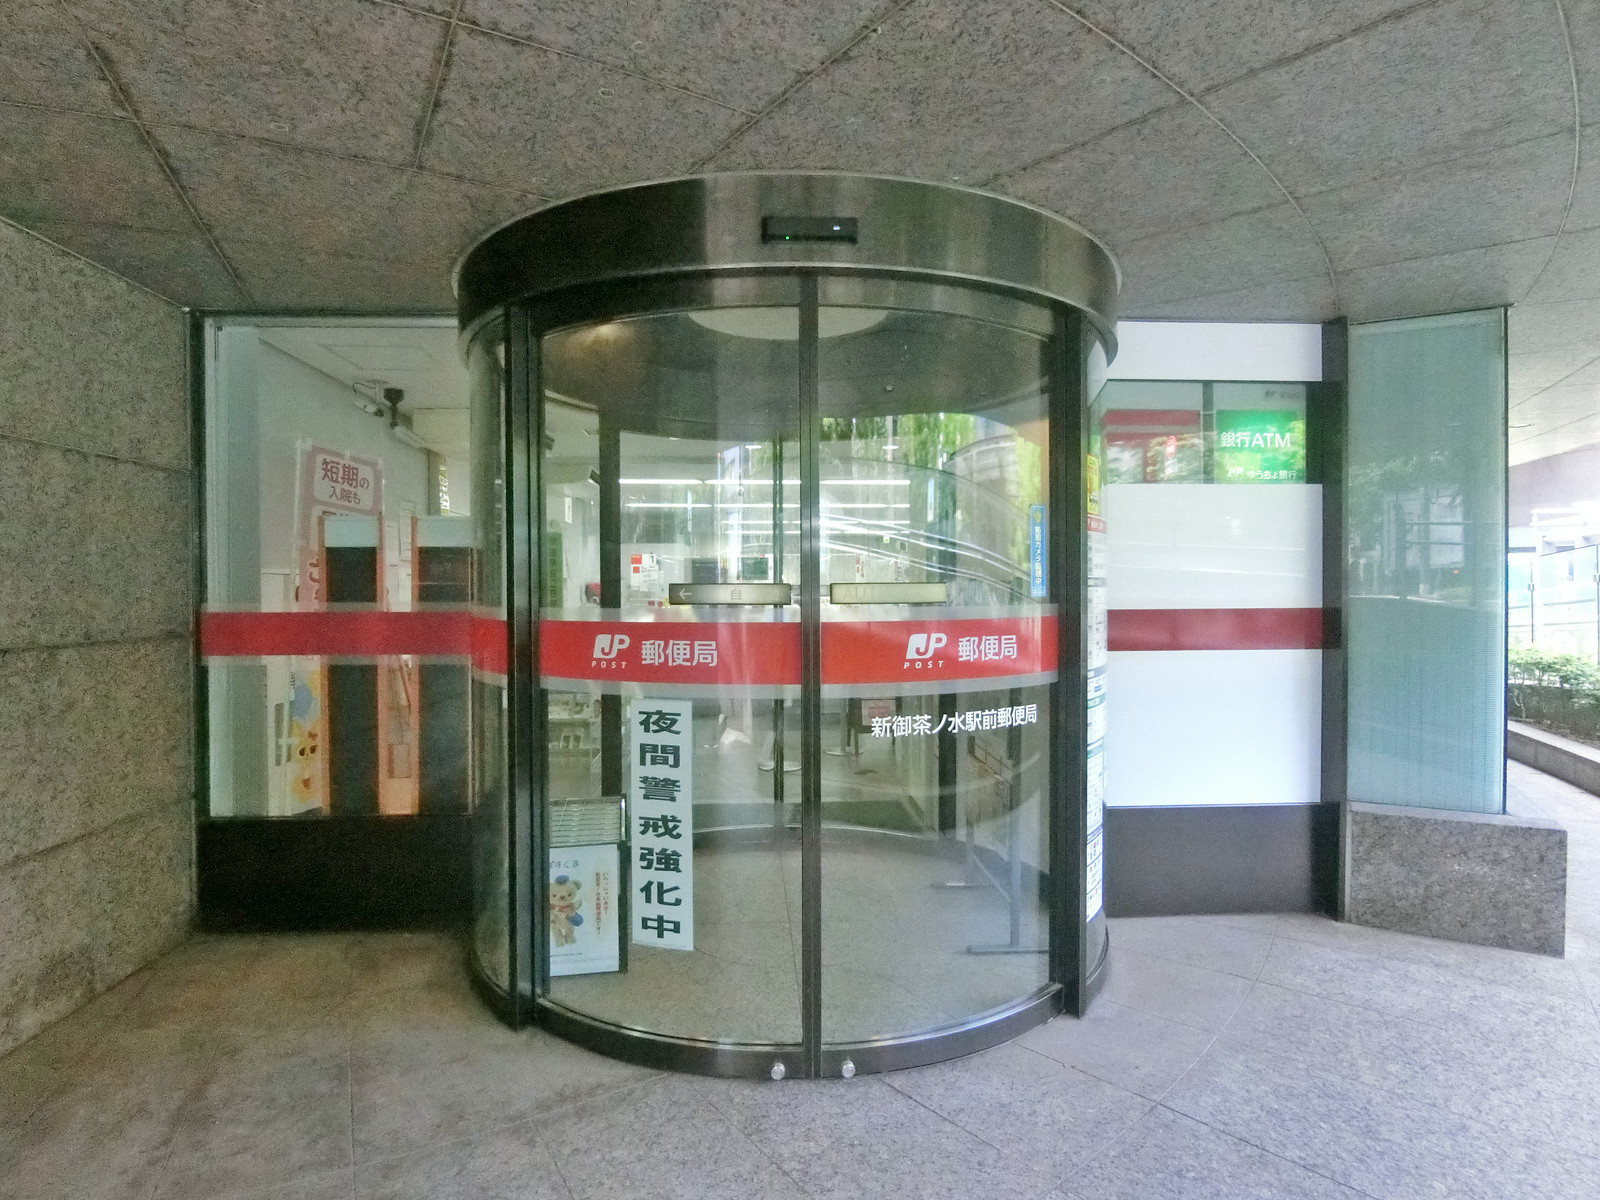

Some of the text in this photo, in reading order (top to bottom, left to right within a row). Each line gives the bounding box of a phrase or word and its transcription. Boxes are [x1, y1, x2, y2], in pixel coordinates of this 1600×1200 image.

[1221, 432, 1291, 448] 銀行ATM
[321, 458, 370, 490] 短期の
[1247, 469, 1297, 480] ゆうちょ銀行
[328, 485, 361, 505] 入院も
[641, 640, 718, 666] 郵便局
[958, 635, 1017, 661] 郵便局
[591, 660, 628, 669] POST
[903, 660, 945, 669] POST
[871, 704, 1037, 738] 新御茶ノ水駅前郵便局
[638, 709, 682, 938] 夜間警戒強化中
